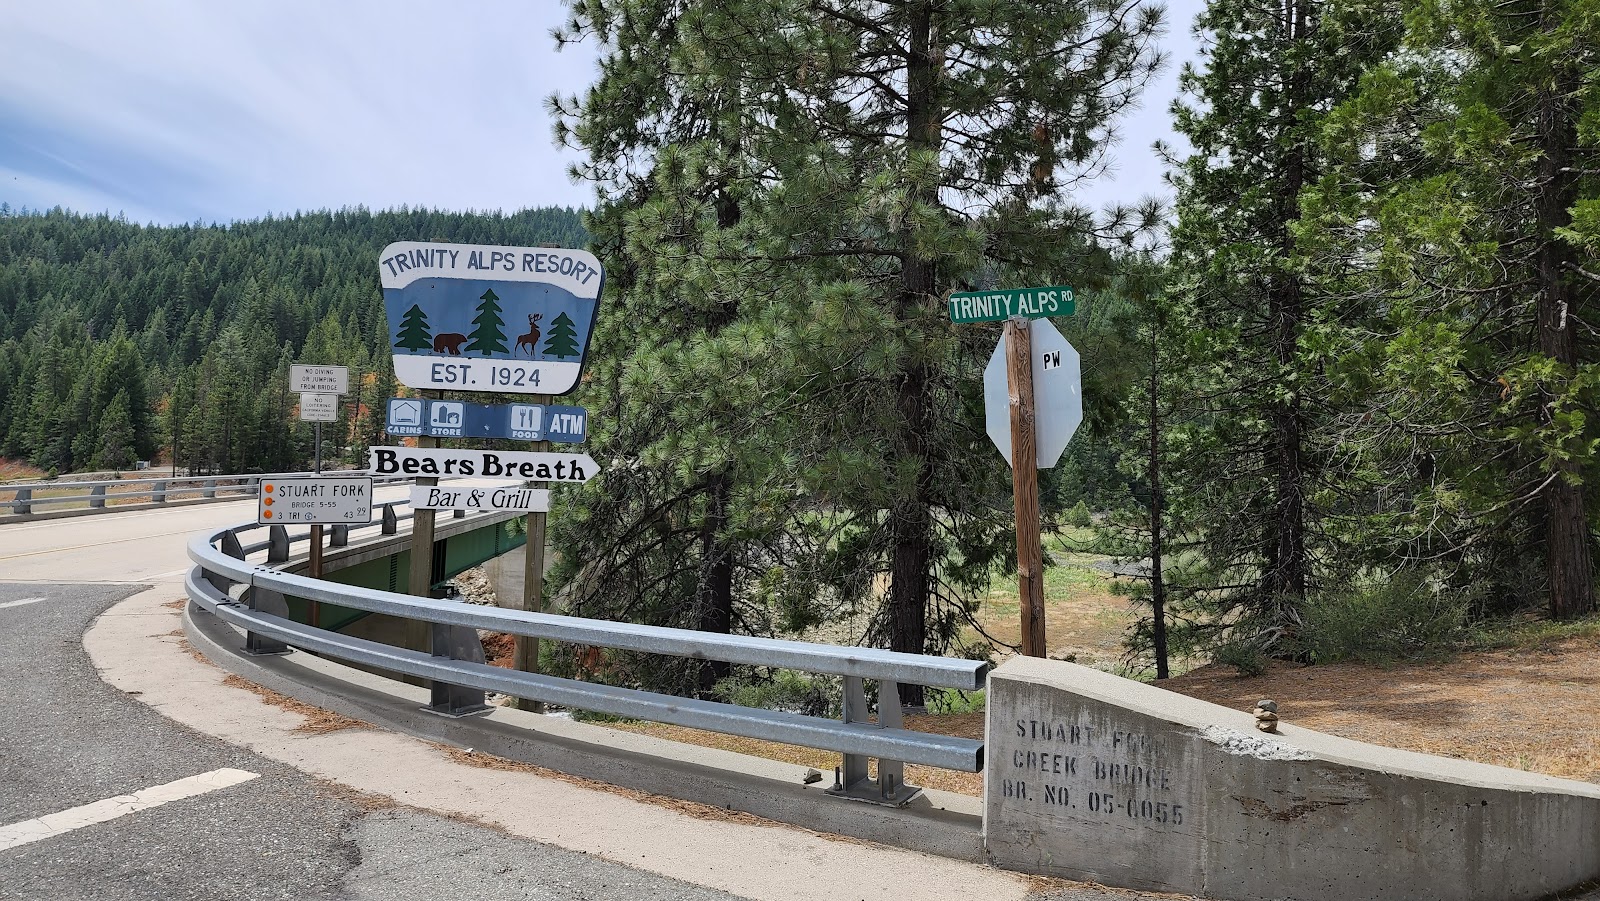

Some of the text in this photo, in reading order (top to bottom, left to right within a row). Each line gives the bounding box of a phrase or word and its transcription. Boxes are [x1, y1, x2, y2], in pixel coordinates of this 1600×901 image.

[382, 249, 598, 285] TRINITY ALPS RESORT
[950, 290, 1073, 319] TRINITY ALPS RD
[431, 363, 541, 387] EST. 1924
[387, 426, 422, 434] CABINS
[431, 427, 461, 436] STORE
[512, 430, 538, 439] FOOD
[550, 413, 584, 435] ATM
[375, 449, 586, 480] Bears Breath
[279, 485, 364, 497] STUART FORK
[426, 488, 532, 509] Bar & Grill
[289, 512, 300, 520] TRI
[344, 511, 354, 519] 43
[356, 506, 367, 516] 99
[1016, 719, 1094, 745] STUART
[1013, 750, 1171, 790] CREEK BRIDGE
[1003, 779, 1183, 825] BR. NO. 05-0055
